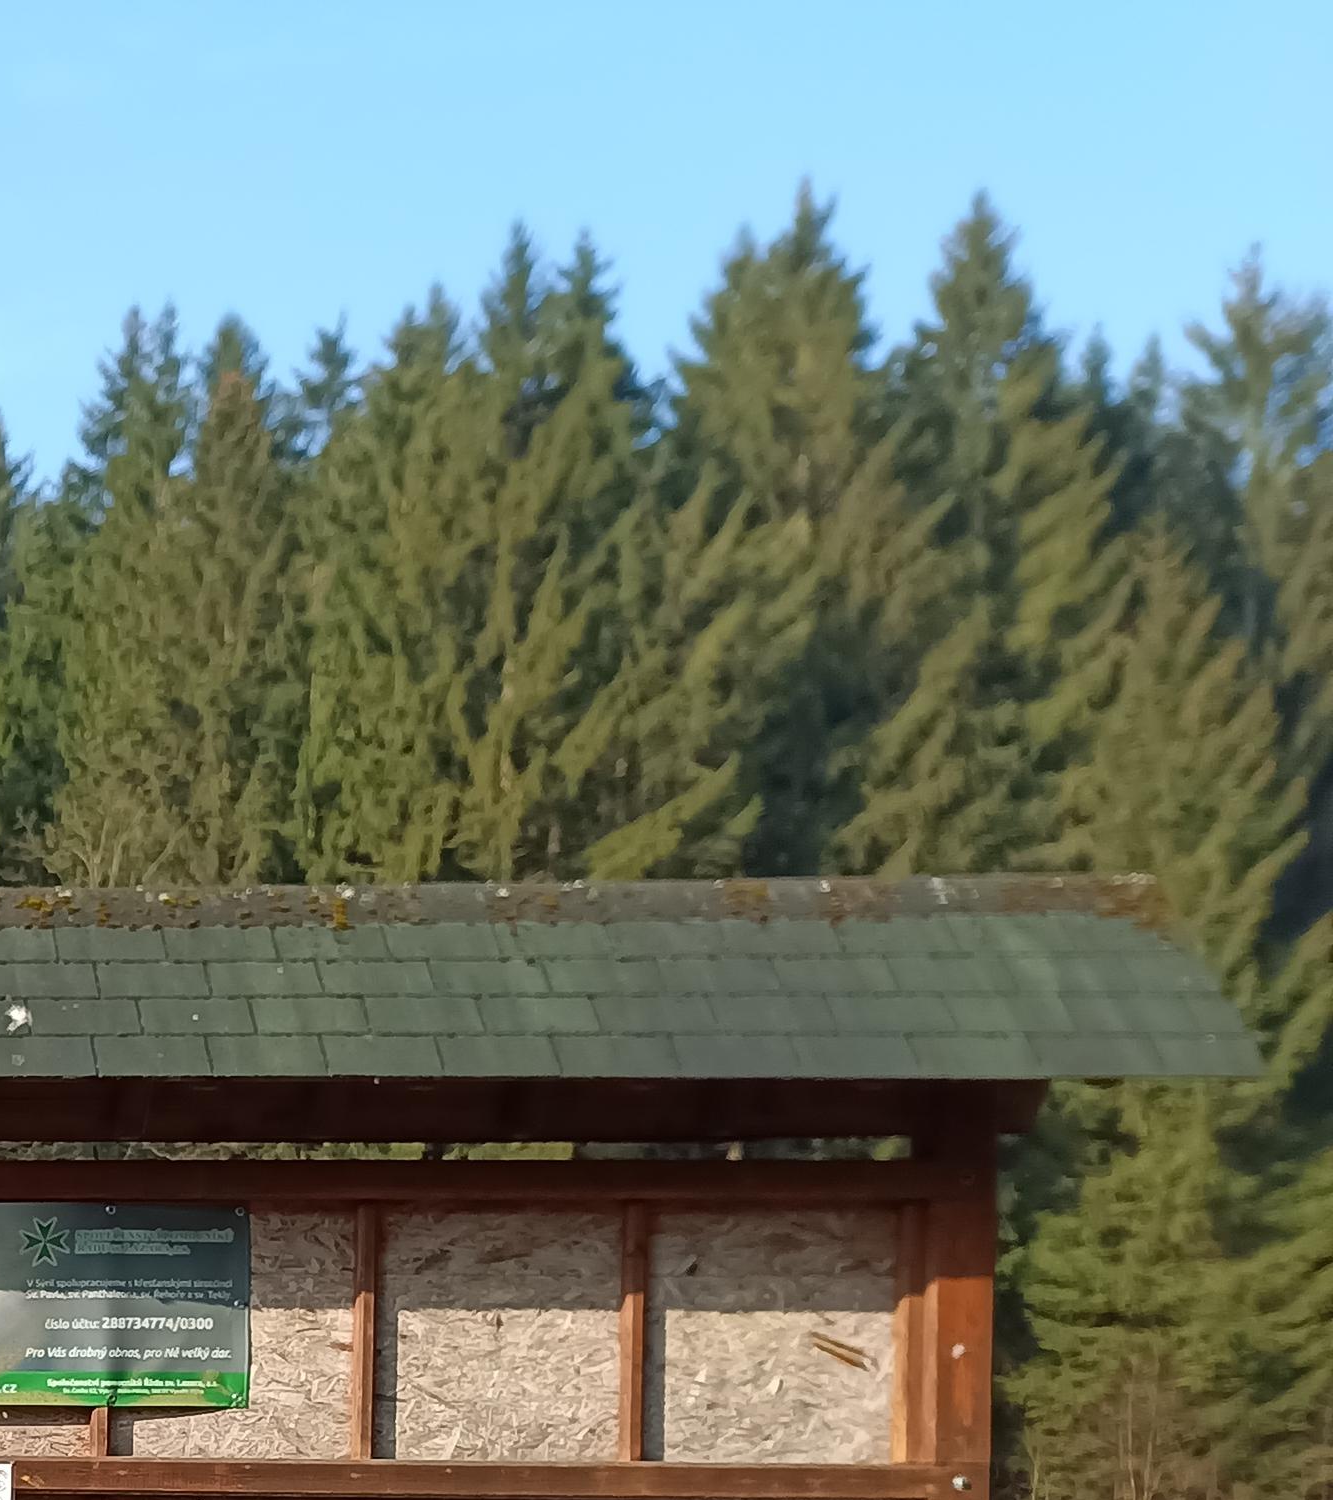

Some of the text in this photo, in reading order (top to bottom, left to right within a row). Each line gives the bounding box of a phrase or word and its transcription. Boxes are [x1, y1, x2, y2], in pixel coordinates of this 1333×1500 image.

[44, 1317, 70, 1330] číslo
[101, 1317, 214, 1331] 288734774/0300
[25, 1348, 44, 1358] Pro
[47, 1347, 66, 1358] Vás
[69, 1347, 107, 1360] drobný
[109, 1348, 141, 1359] obnos,
[143, 1350, 162, 1360] pro
[181, 1347, 209, 1360] velký
[211, 1348, 232, 1359] dar.
